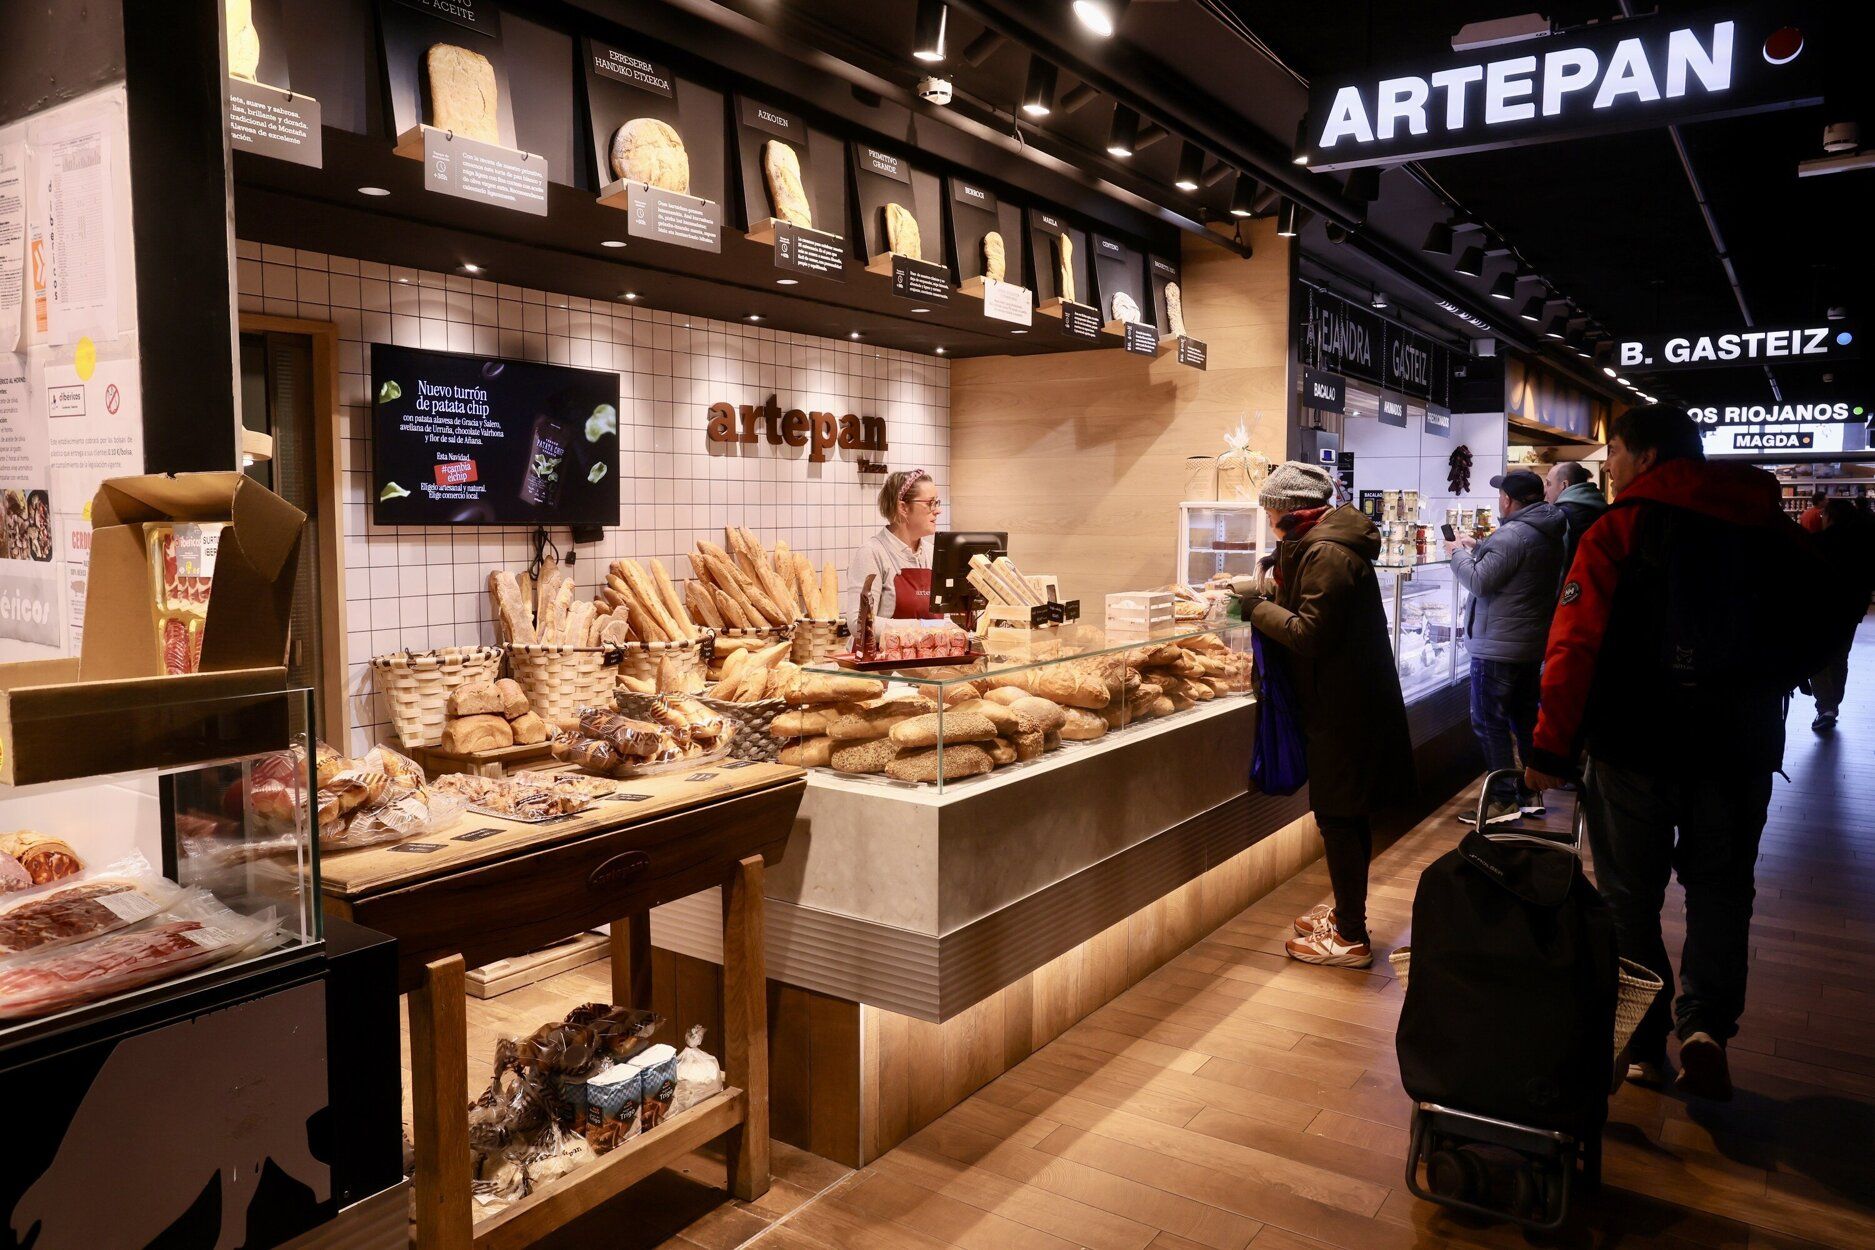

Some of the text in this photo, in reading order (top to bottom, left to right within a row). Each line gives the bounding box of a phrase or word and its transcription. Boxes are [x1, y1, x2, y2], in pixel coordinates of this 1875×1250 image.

[609, 50, 654, 73] ERRESERBA
[595, 57, 670, 90] HANDIKO ETXEKOA
[1318, 21, 1734, 148] ARTEPAN
[248, 108, 276, 120] brillante
[758, 110, 788, 128] AZKOIEN
[268, 122, 278, 130] de
[1620, 328, 1828, 366] B. GASTEIZ
[1392, 340, 1428, 386] GASTEIZ
[418, 380, 487, 401] Nuevo turrón
[1314, 382, 1336, 402] BACALAO
[416, 396, 490, 418] de patata chip
[1687, 404, 1848, 423] OS RIOJANOS
[414, 416, 432, 424] patata
[434, 416, 454, 424] alavesa
[462, 418, 479, 426] Gracia
[707, 394, 888, 462] artepan
[430, 434, 440, 442] flor
[440, 434, 448, 442] de
[455, 428, 480, 436] chocolate
[1736, 435, 1799, 448] MAGDA
[437, 452, 448, 460] Esta
[441, 462, 472, 474] #cambia
[447, 472, 467, 482] elchip
[620, 1108, 636, 1120] Trigo
